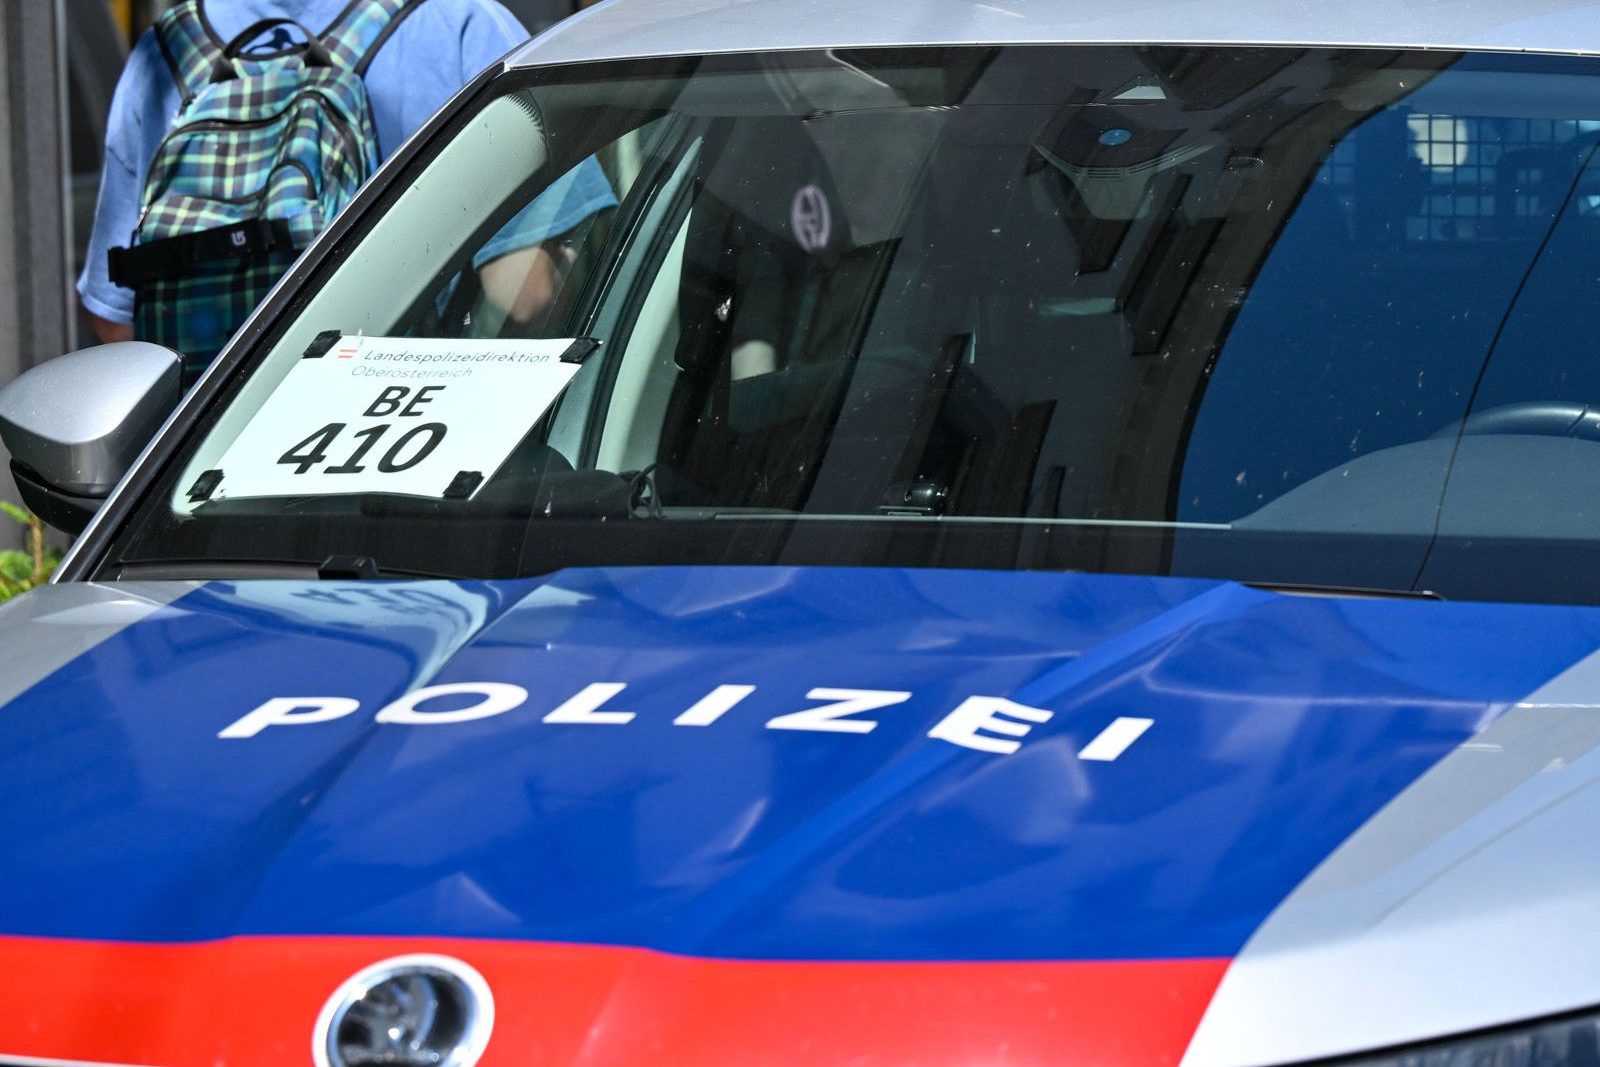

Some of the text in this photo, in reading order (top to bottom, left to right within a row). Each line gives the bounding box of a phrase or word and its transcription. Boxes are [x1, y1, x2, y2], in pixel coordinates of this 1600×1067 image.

[351, 365, 473, 379] Oberösterreich
[364, 349, 551, 365] Landespolizeidirektion
[363, 386, 447, 417] BE
[277, 423, 449, 475] 410
[217, 682, 1155, 762] POLIZEI
